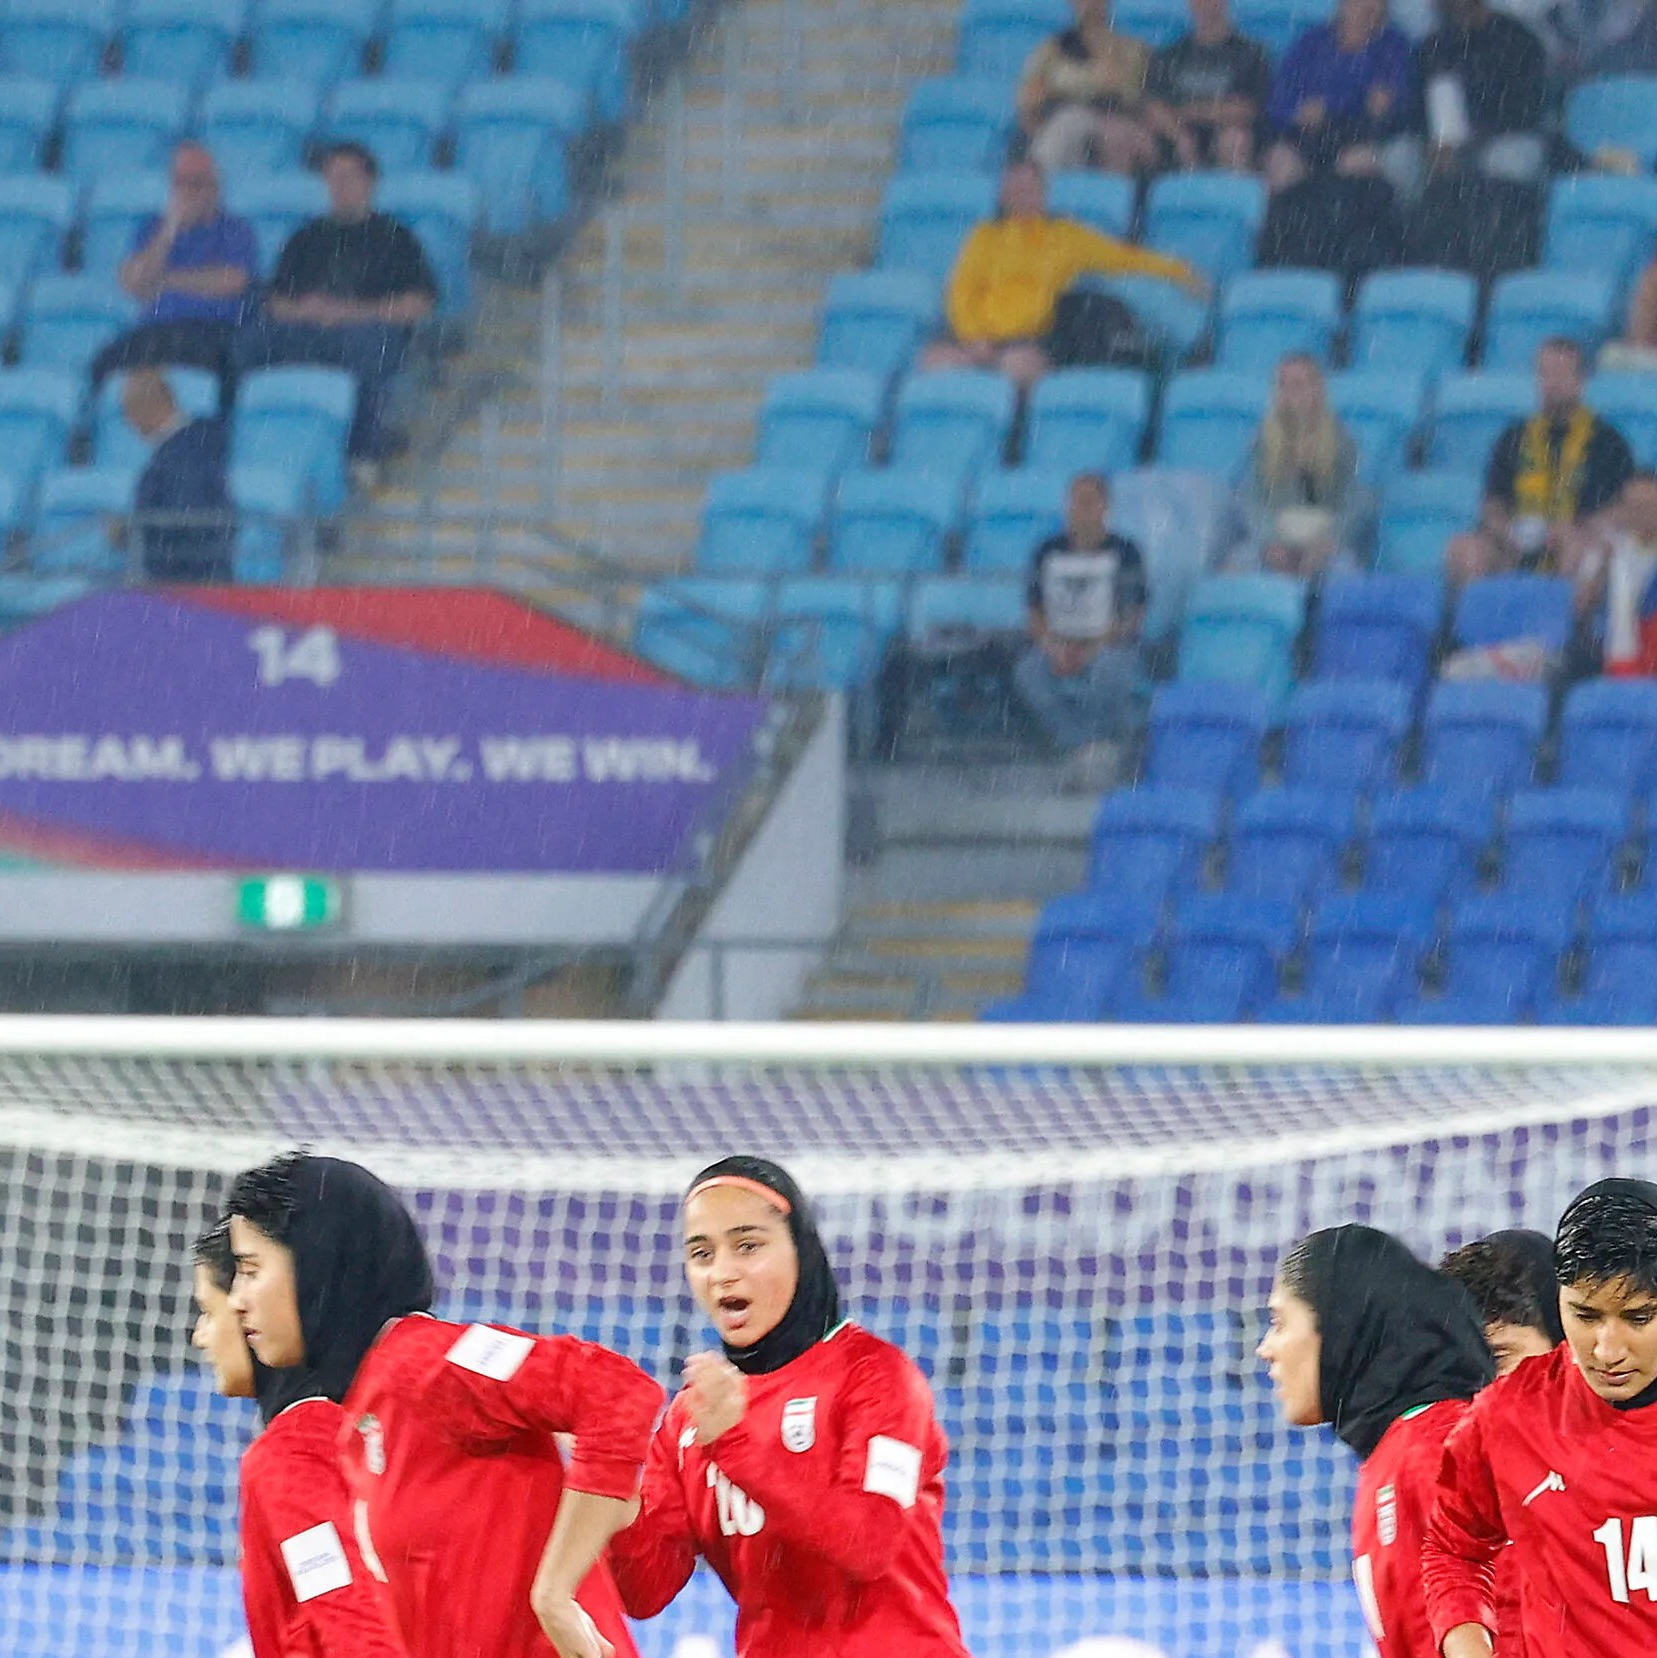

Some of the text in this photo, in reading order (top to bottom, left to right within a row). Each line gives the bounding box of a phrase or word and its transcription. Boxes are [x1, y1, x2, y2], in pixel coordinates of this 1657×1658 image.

[246, 625, 341, 686] 14
[209, 732, 308, 782] WE
[310, 732, 473, 783] PLAY.
[479, 732, 579, 783] WE
[582, 732, 714, 783] WIN.
